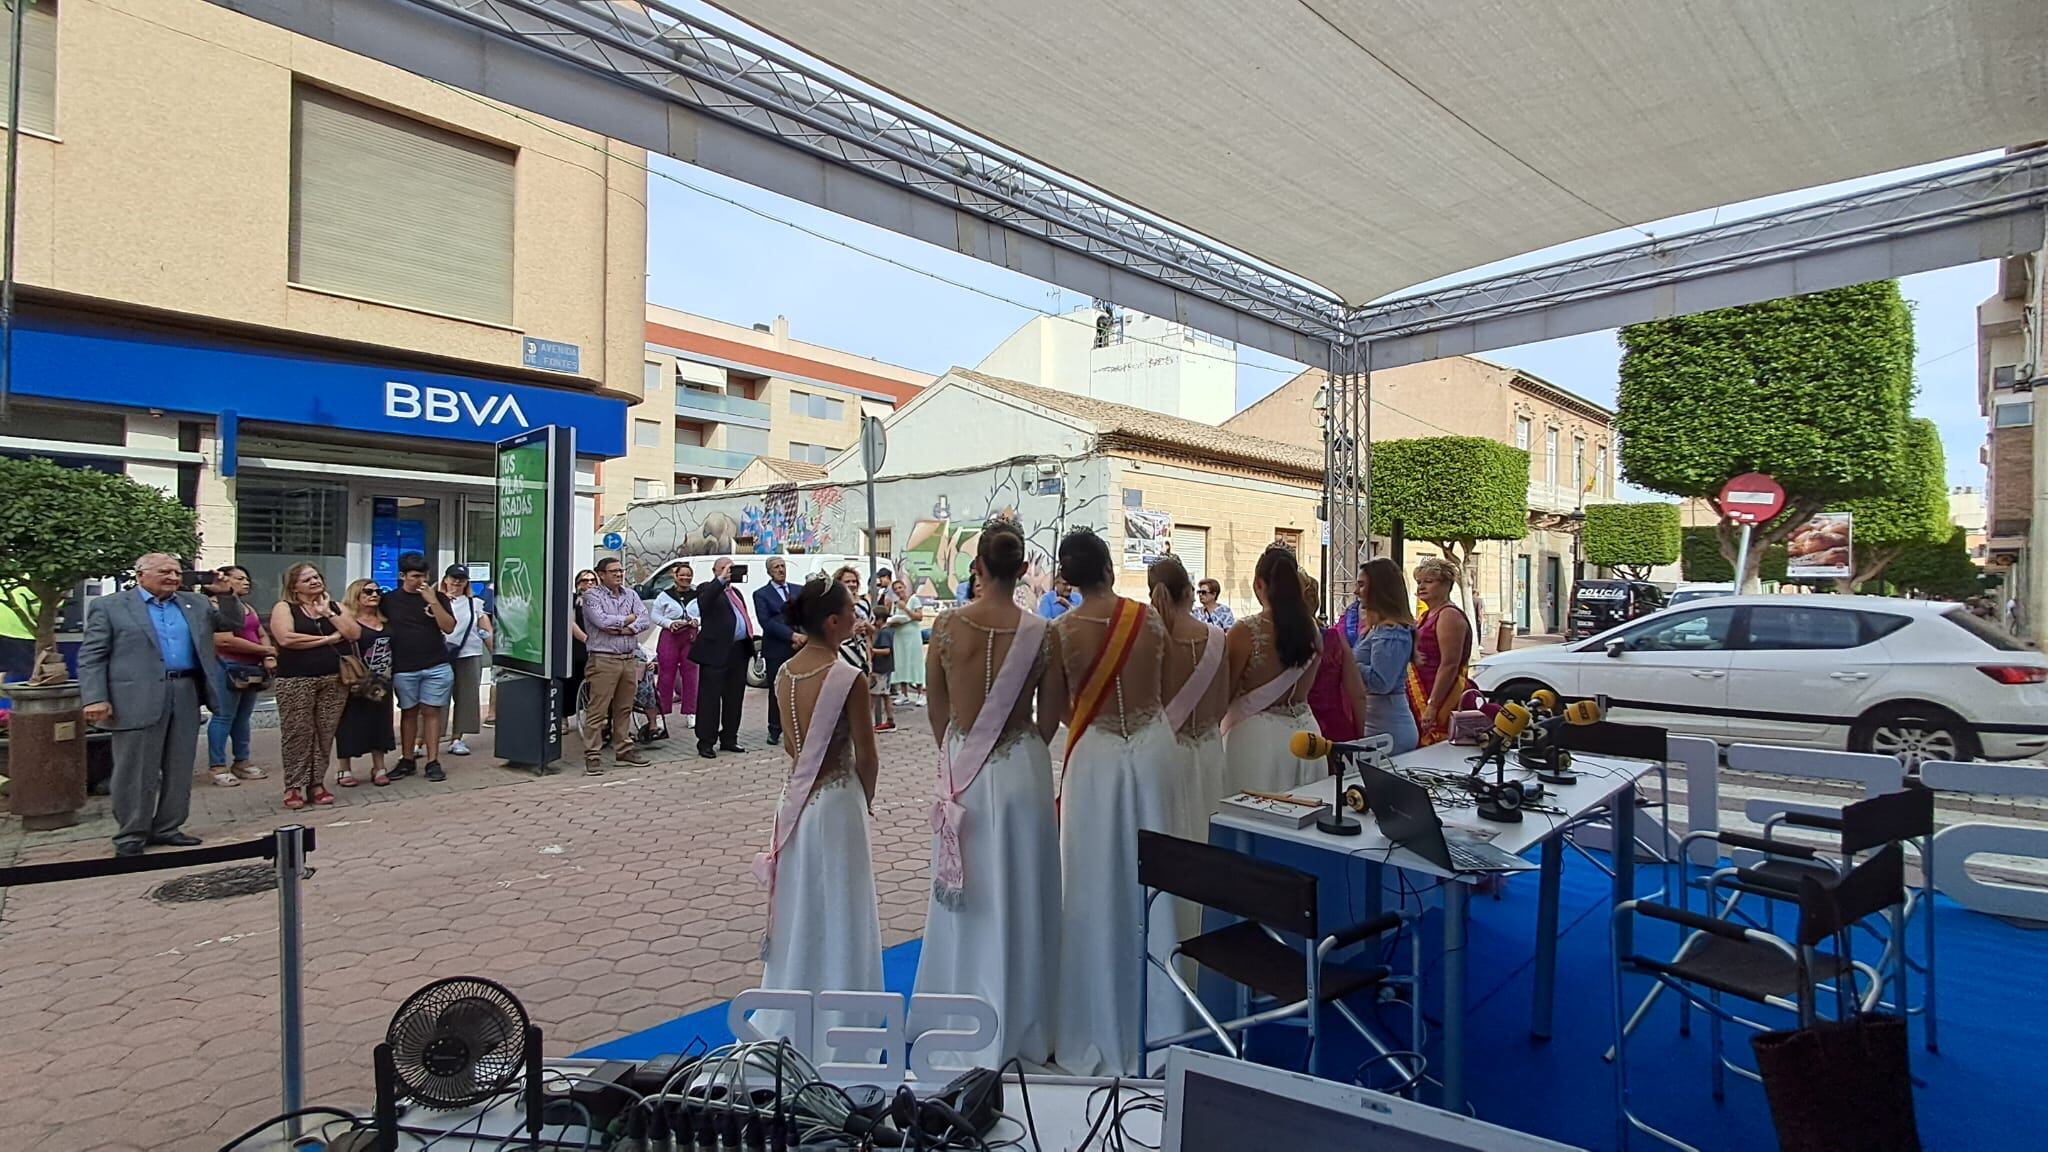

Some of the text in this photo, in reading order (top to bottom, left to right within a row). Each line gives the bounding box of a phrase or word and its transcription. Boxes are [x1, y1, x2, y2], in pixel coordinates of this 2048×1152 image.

[524, 353, 537, 365] DE
[385, 381, 529, 428] BBVA
[500, 453, 516, 475] TUS
[500, 474, 524, 496] PILAS
[500, 494, 533, 516] USADAS
[549, 687, 558, 744] PILAS
